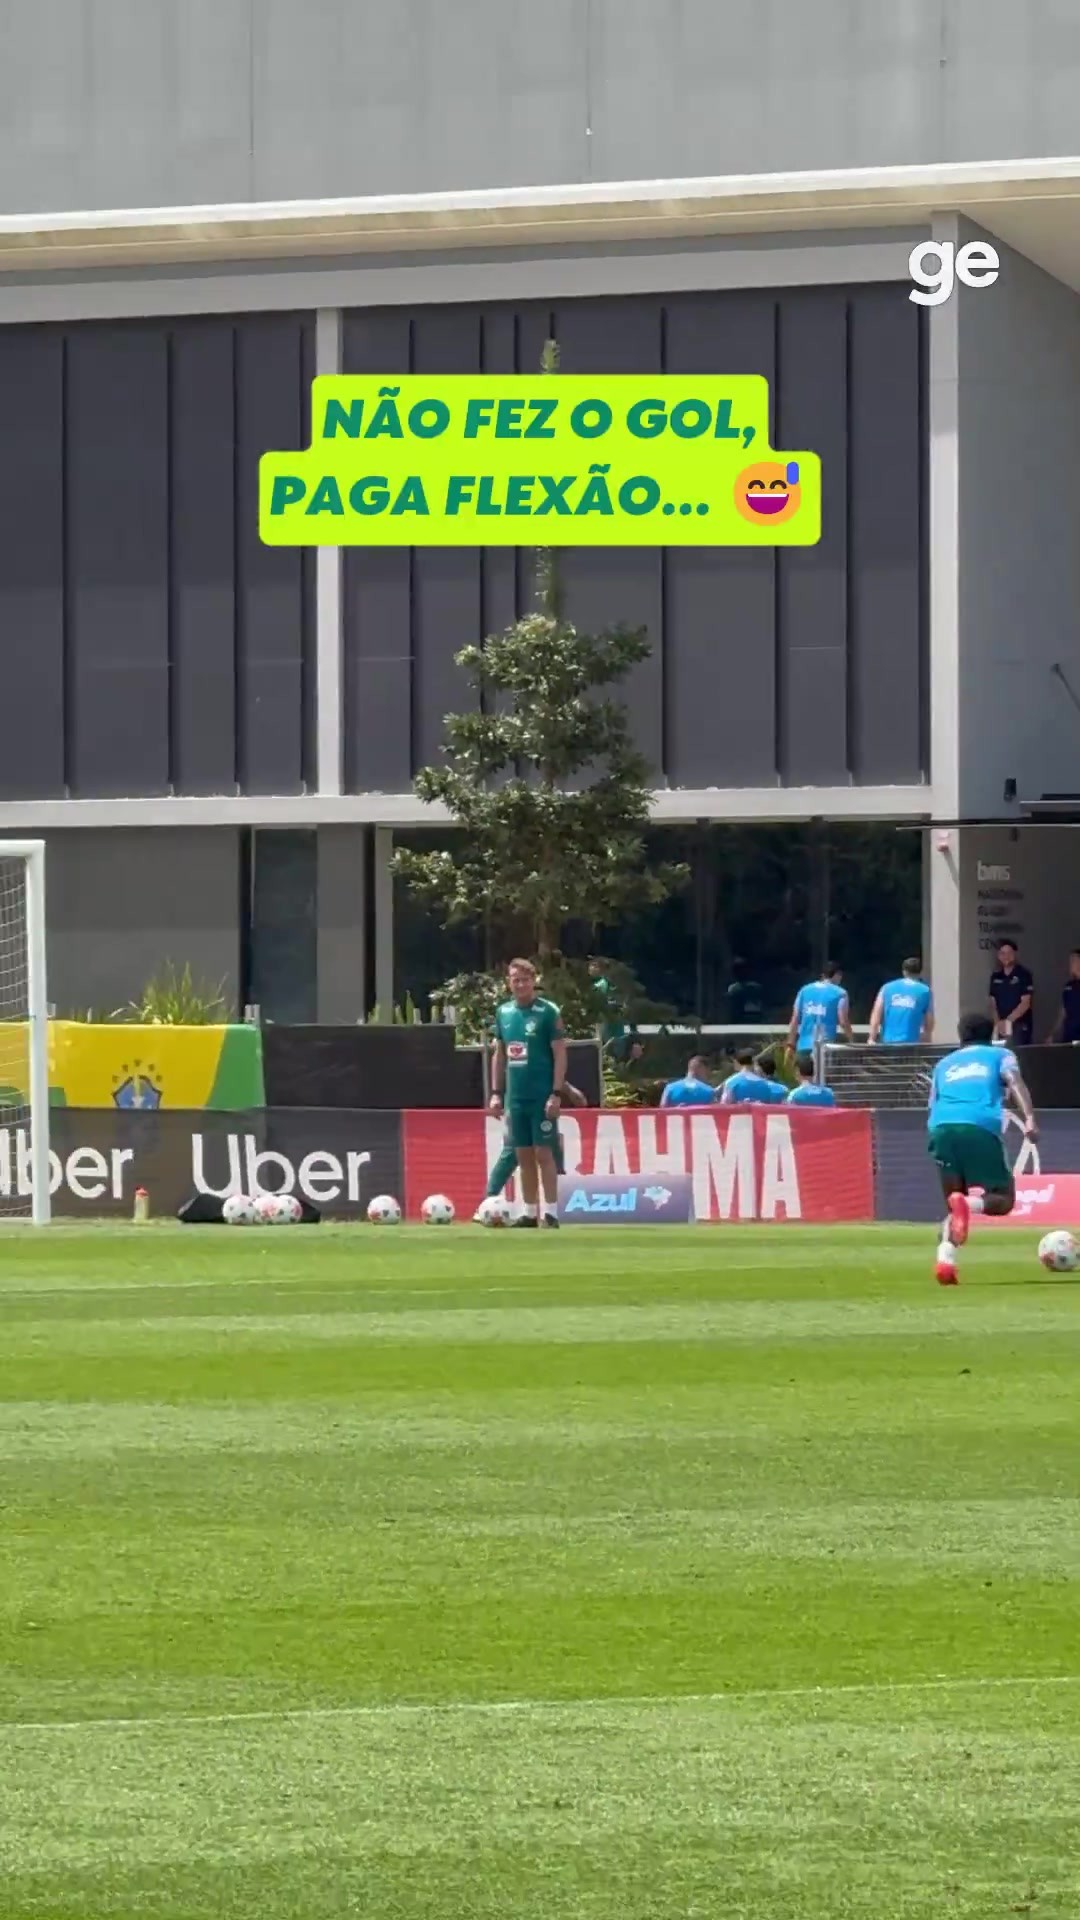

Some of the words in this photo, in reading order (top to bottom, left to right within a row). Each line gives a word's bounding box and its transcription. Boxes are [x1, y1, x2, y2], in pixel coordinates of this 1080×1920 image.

[0, 1128, 134, 1199] ber
[192, 1133, 372, 1201] Uber
[565, 1187, 638, 1213] Azul
